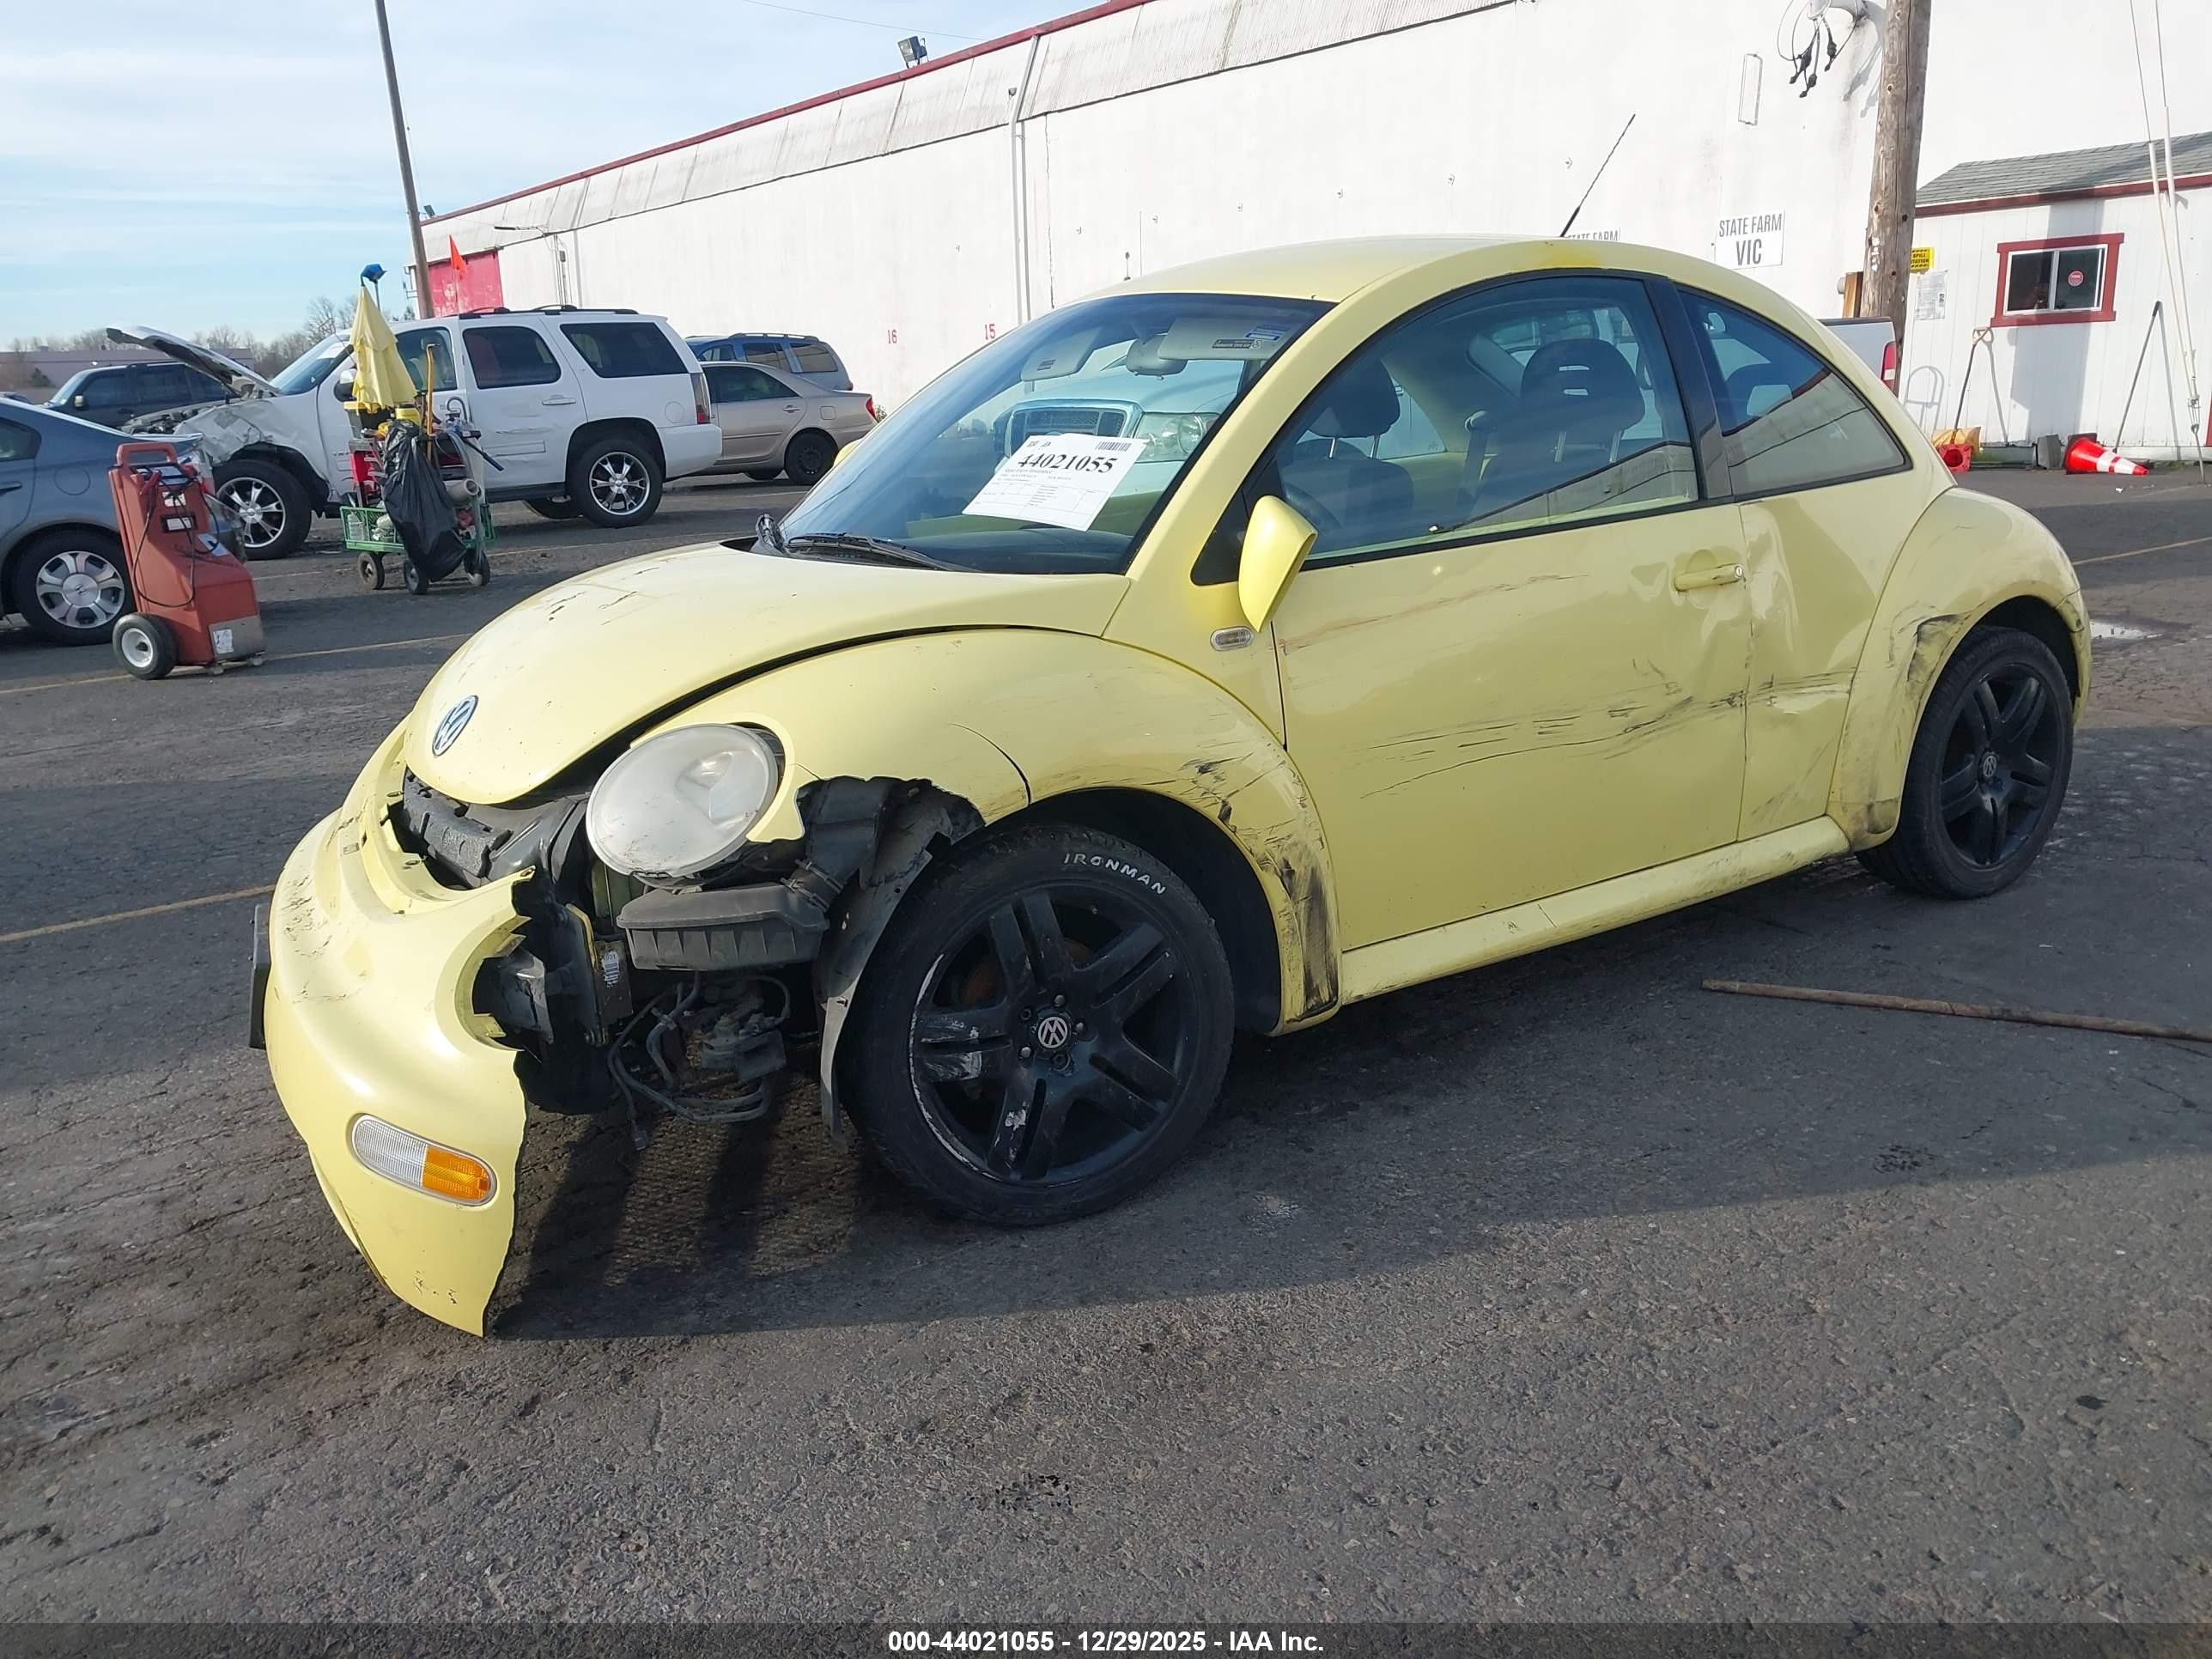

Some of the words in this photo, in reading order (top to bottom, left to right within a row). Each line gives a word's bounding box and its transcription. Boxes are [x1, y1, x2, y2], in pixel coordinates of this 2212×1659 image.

[1719, 217, 1748, 237] STATE
[1751, 213, 1782, 234] FARM
[1735, 238, 1762, 265] VIC
[887, 329, 897, 343] 16
[984, 323, 996, 340] 15
[1018, 453, 1119, 474] 44021055
[1063, 852, 1167, 895] IRONMAN
